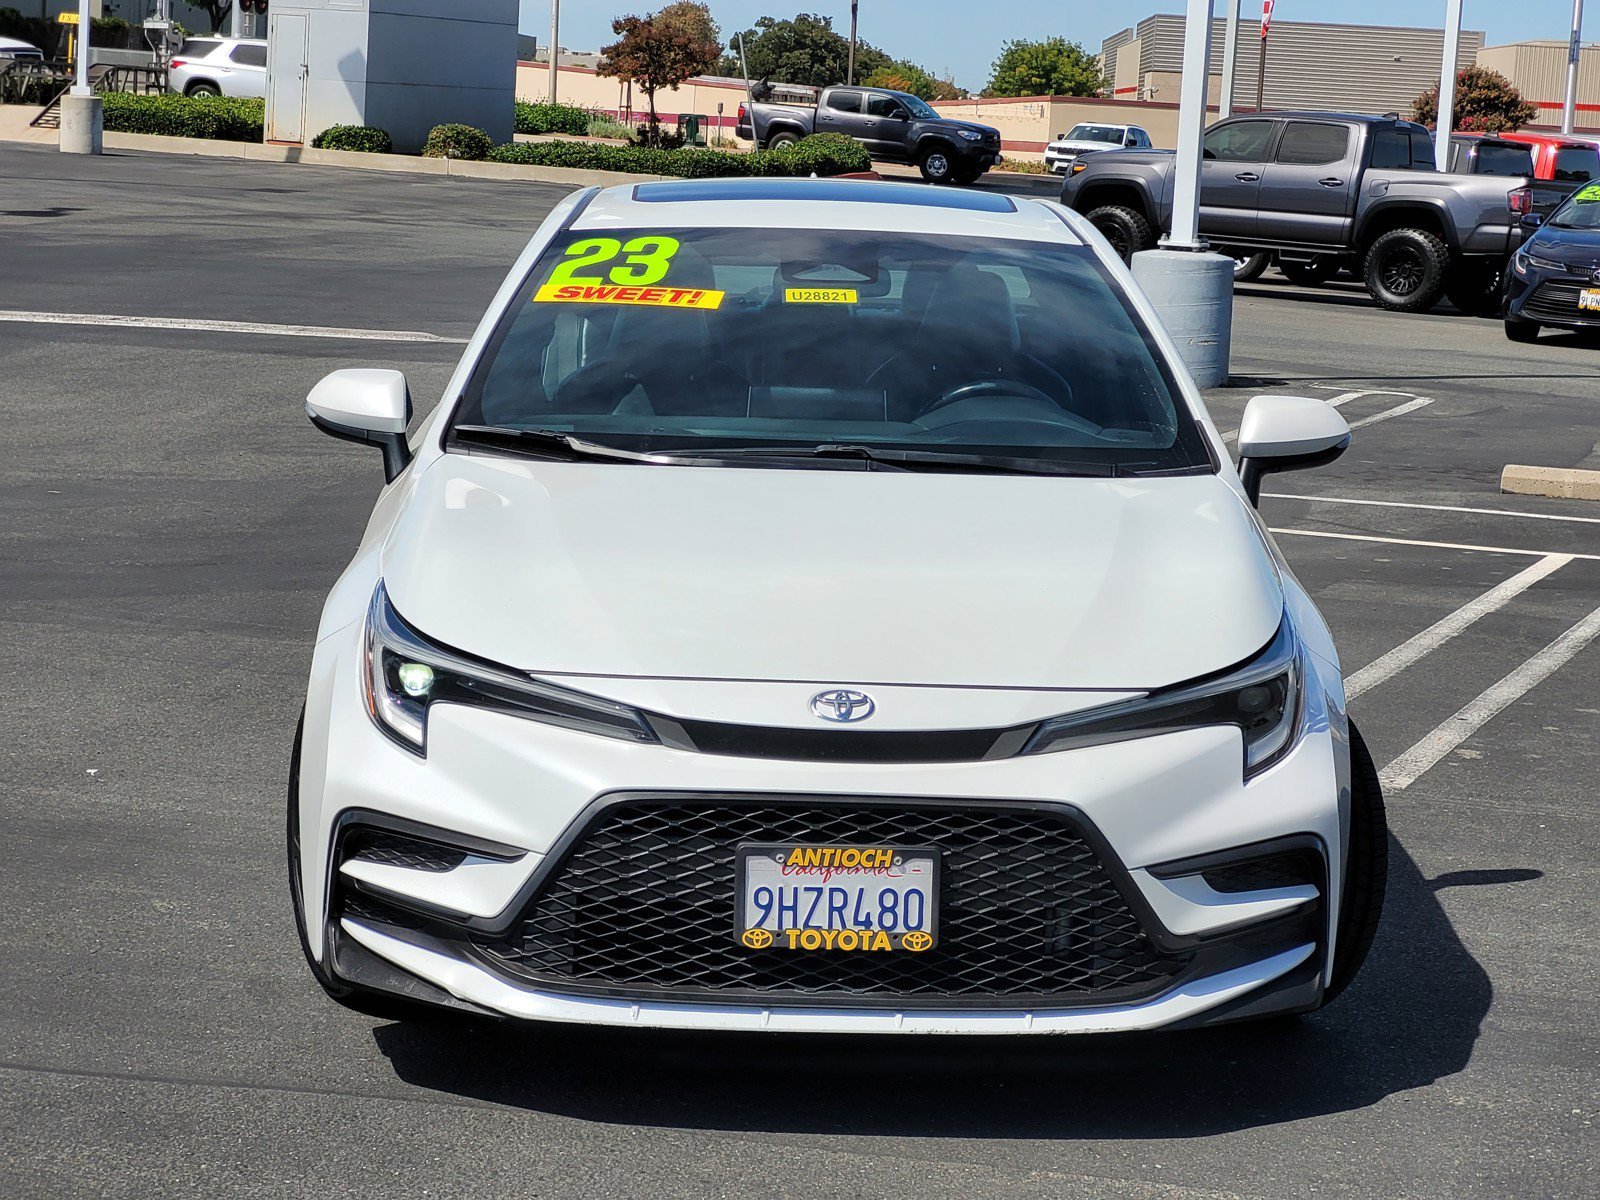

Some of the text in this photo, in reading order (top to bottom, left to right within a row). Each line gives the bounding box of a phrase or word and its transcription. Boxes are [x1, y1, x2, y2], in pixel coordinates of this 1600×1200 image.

[547, 236, 680, 286] 23
[553, 286, 706, 304] SWEET!
[792, 291, 848, 301] U28821
[786, 848, 894, 868] ANTIOCH
[781, 860, 904, 883] California
[754, 887, 924, 931] 9HZR480
[786, 929, 893, 951] TOYOTA
